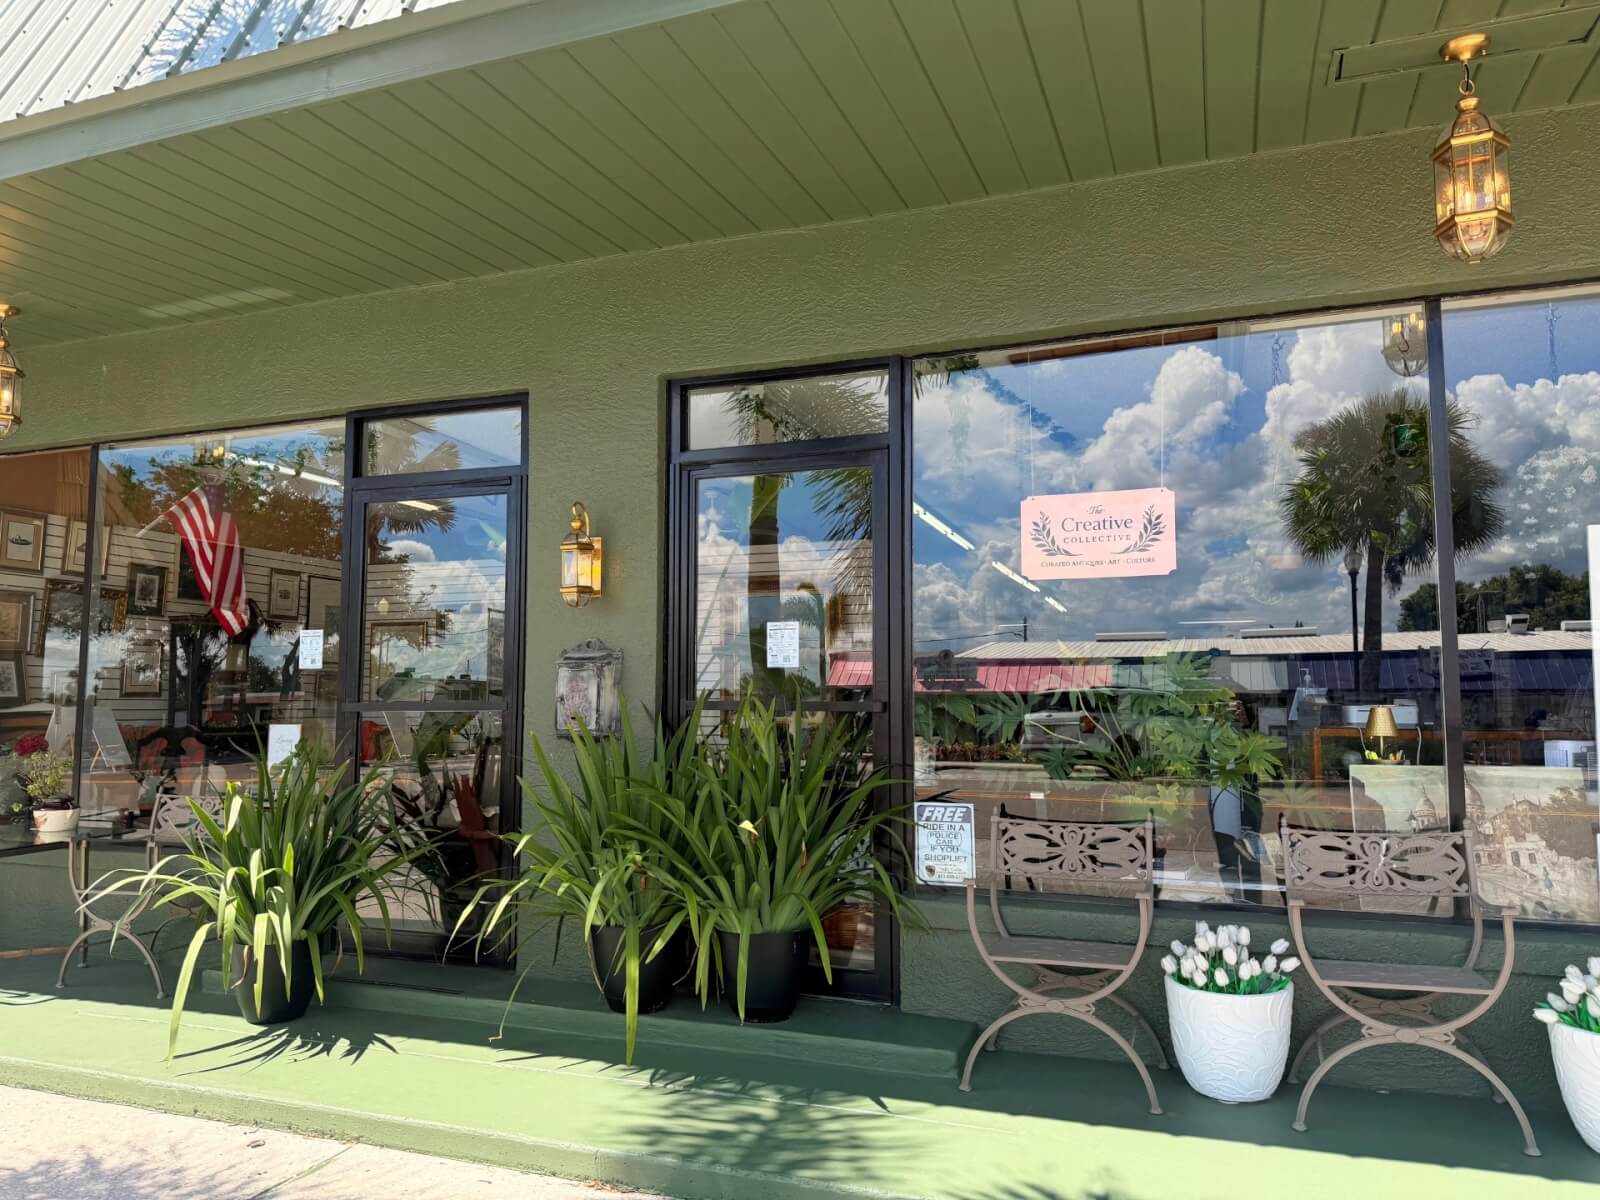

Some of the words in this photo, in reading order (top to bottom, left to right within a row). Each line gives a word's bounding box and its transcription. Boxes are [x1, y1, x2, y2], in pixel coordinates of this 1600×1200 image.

[1086, 504, 1105, 515] The
[1061, 515, 1134, 532] Creative
[1063, 534, 1131, 544] COLLECTIVE
[921, 807, 966, 822] FREE
[923, 823, 944, 831] RIDE
[939, 846, 959, 854] YOU
[924, 854, 968, 863] SHOPLIFT
